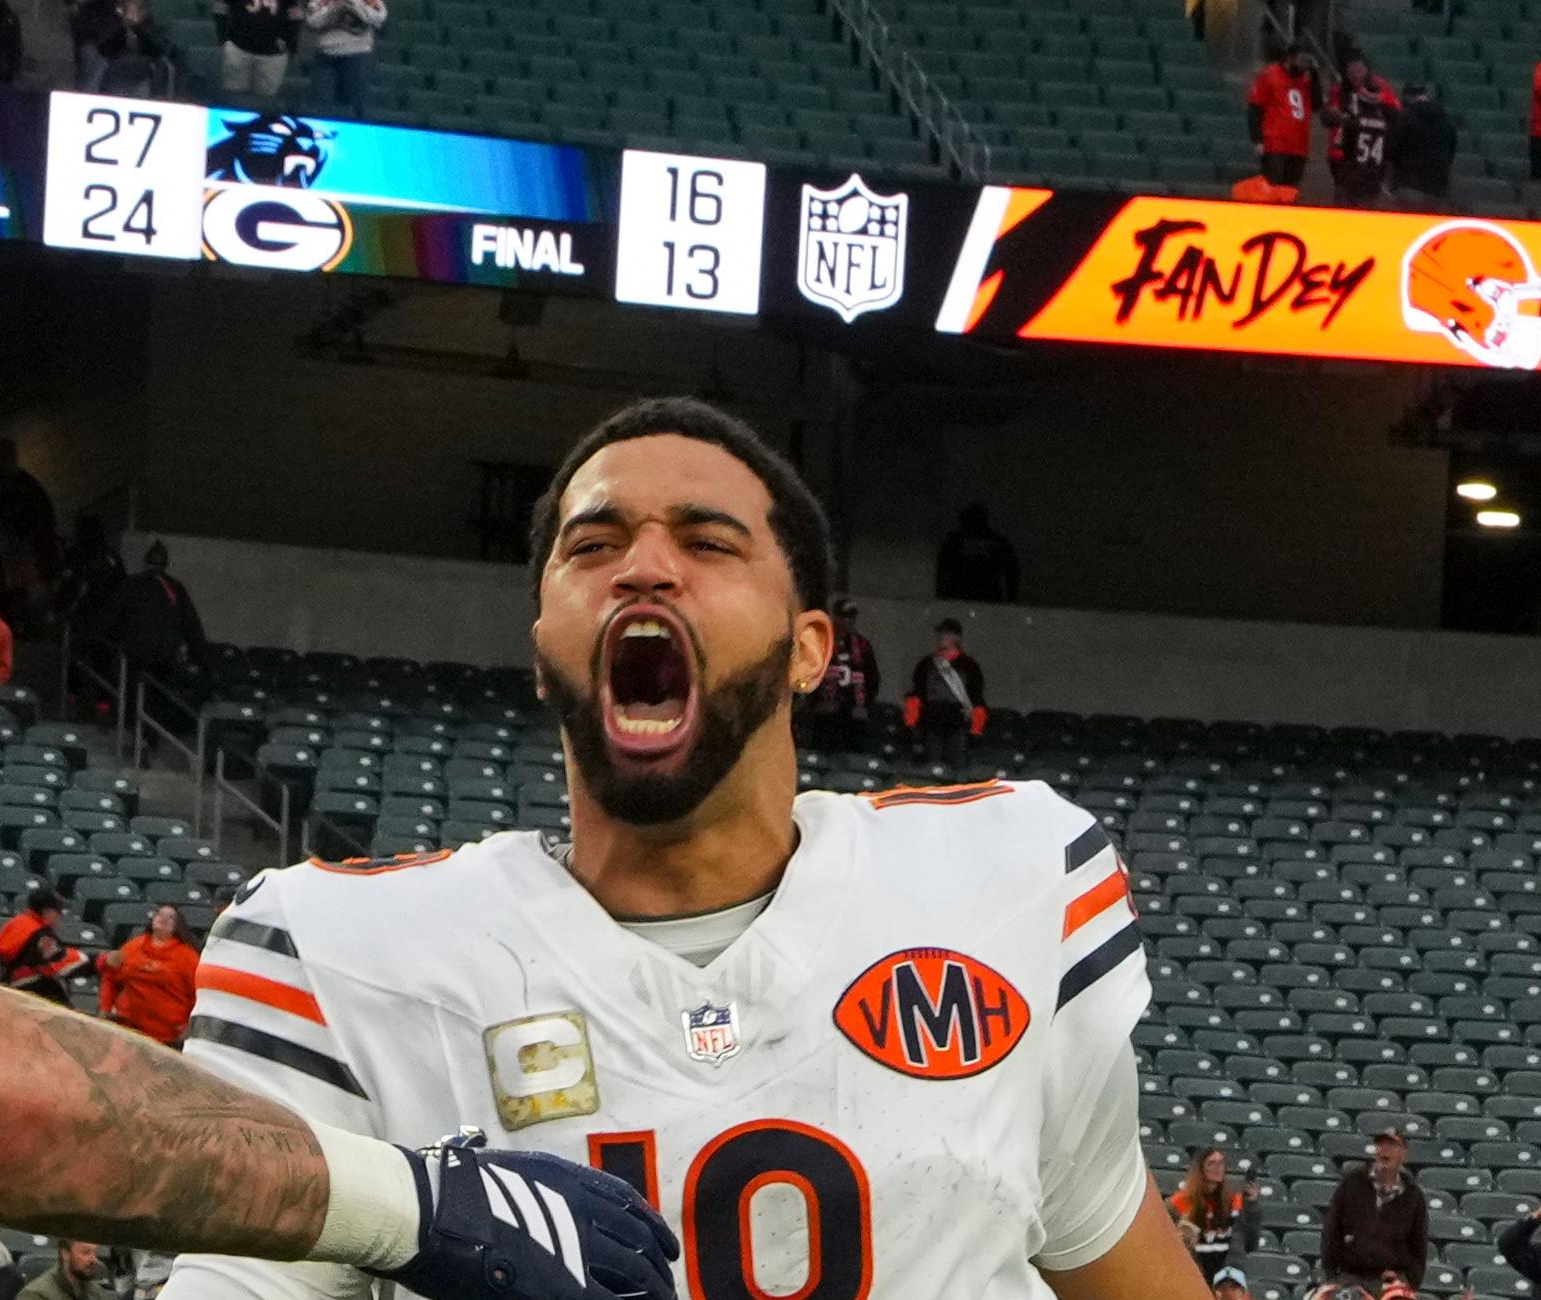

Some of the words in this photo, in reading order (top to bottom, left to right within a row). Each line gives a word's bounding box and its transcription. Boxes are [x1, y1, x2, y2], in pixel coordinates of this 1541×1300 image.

[84, 107, 163, 170] 27
[1356, 132, 1384, 165] 54
[81, 188, 158, 246] 24
[665, 166, 724, 226] 16
[471, 223, 584, 276] FINAL
[662, 241, 720, 300] 13
[813, 239, 888, 296] NFL
[693, 1027, 733, 1055] NFL
[858, 959, 1011, 1068] VMH
[493, 1018, 587, 1098] C
